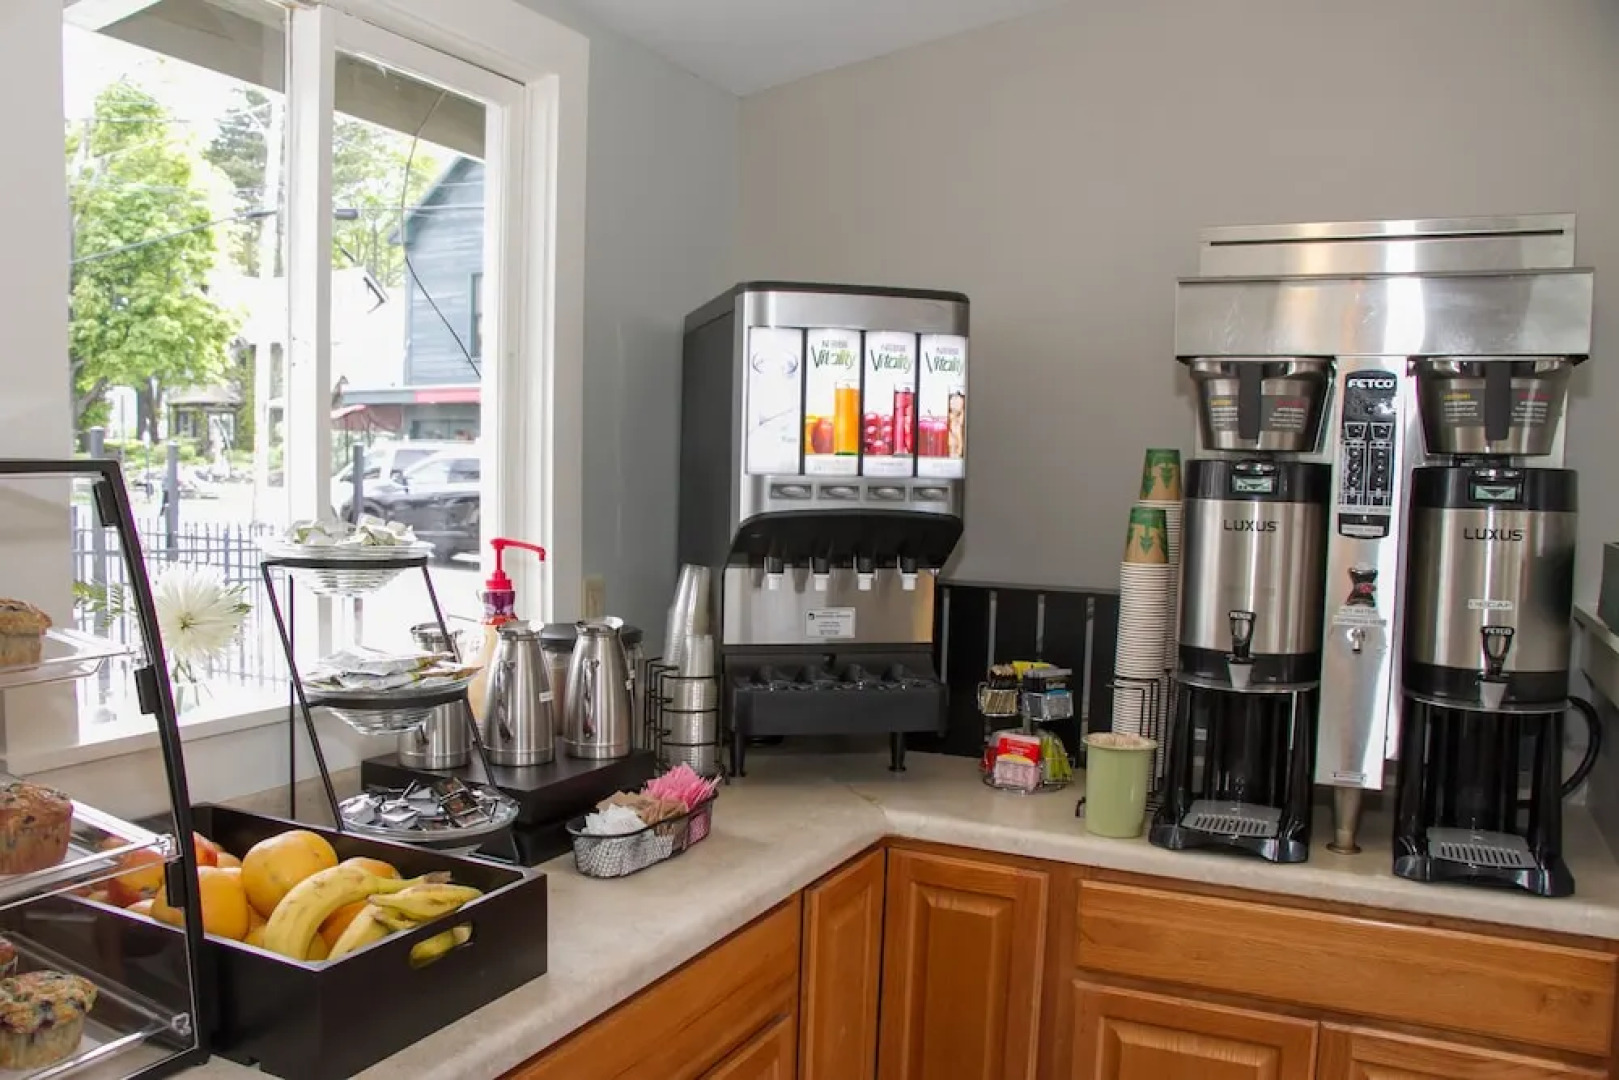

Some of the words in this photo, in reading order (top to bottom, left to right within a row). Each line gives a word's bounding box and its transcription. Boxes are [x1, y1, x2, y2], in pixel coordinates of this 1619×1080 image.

[1347, 378, 1395, 388] FETCO
[1223, 519, 1277, 532] LUXUS
[1463, 527, 1523, 542] LUXUS
